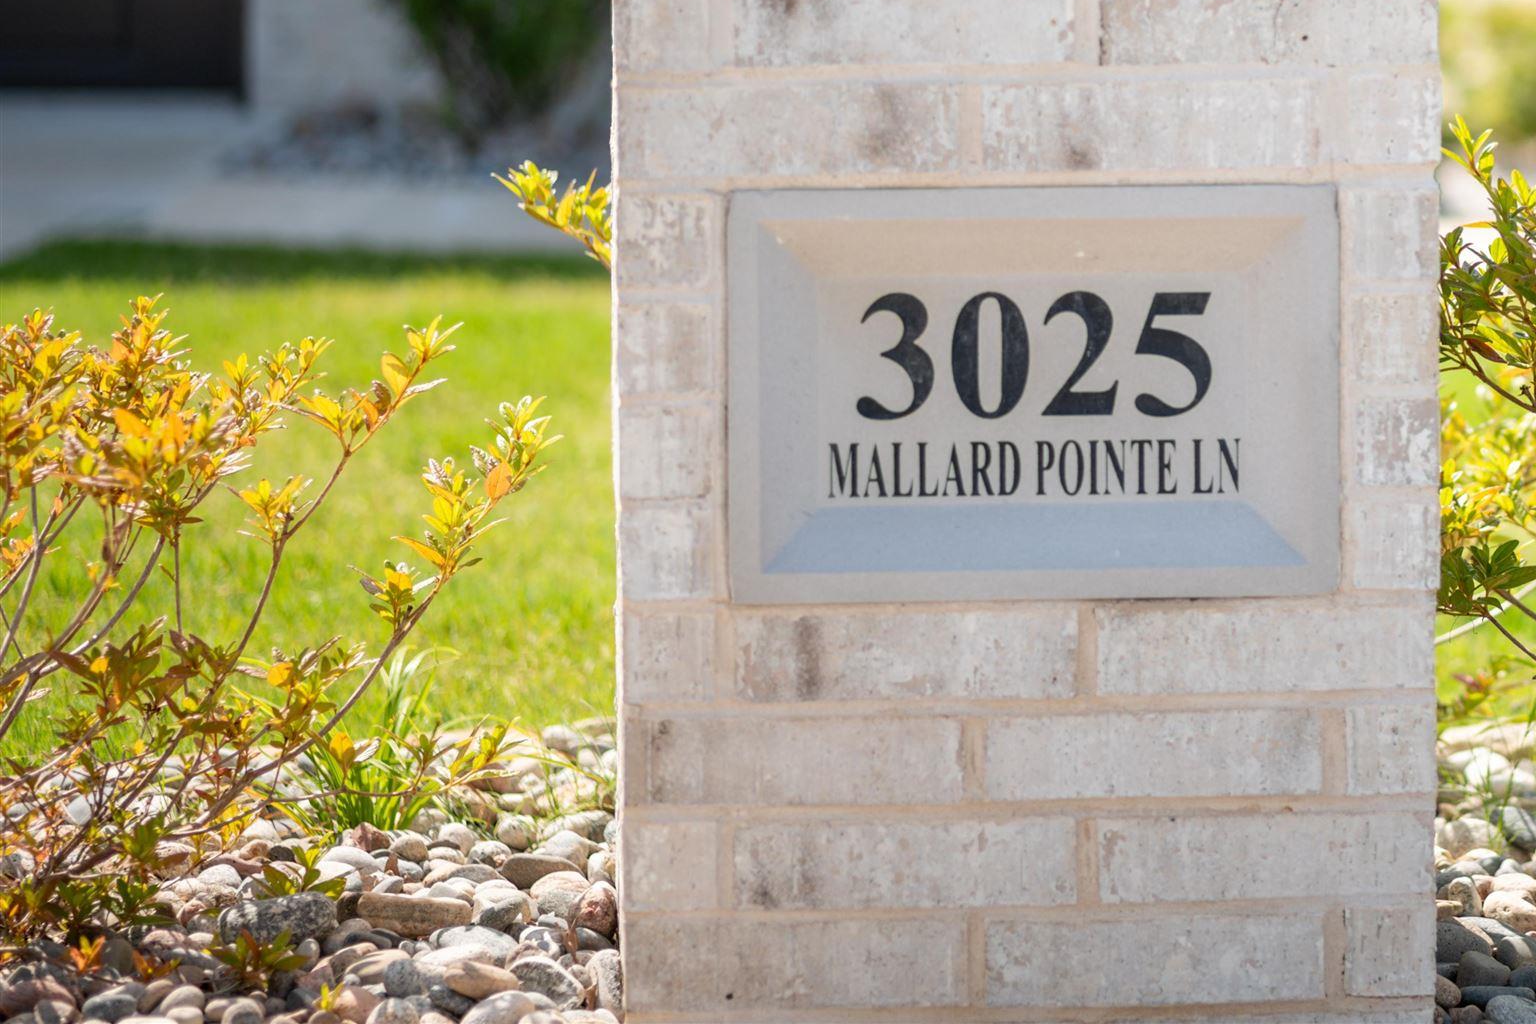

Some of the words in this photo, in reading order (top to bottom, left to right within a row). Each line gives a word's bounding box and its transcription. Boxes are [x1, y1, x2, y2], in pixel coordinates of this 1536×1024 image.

[856, 291, 1213, 420] 3025
[828, 441, 1022, 498] MALLARD
[1035, 439, 1178, 496] POINTE
[1192, 438, 1242, 495] LN
